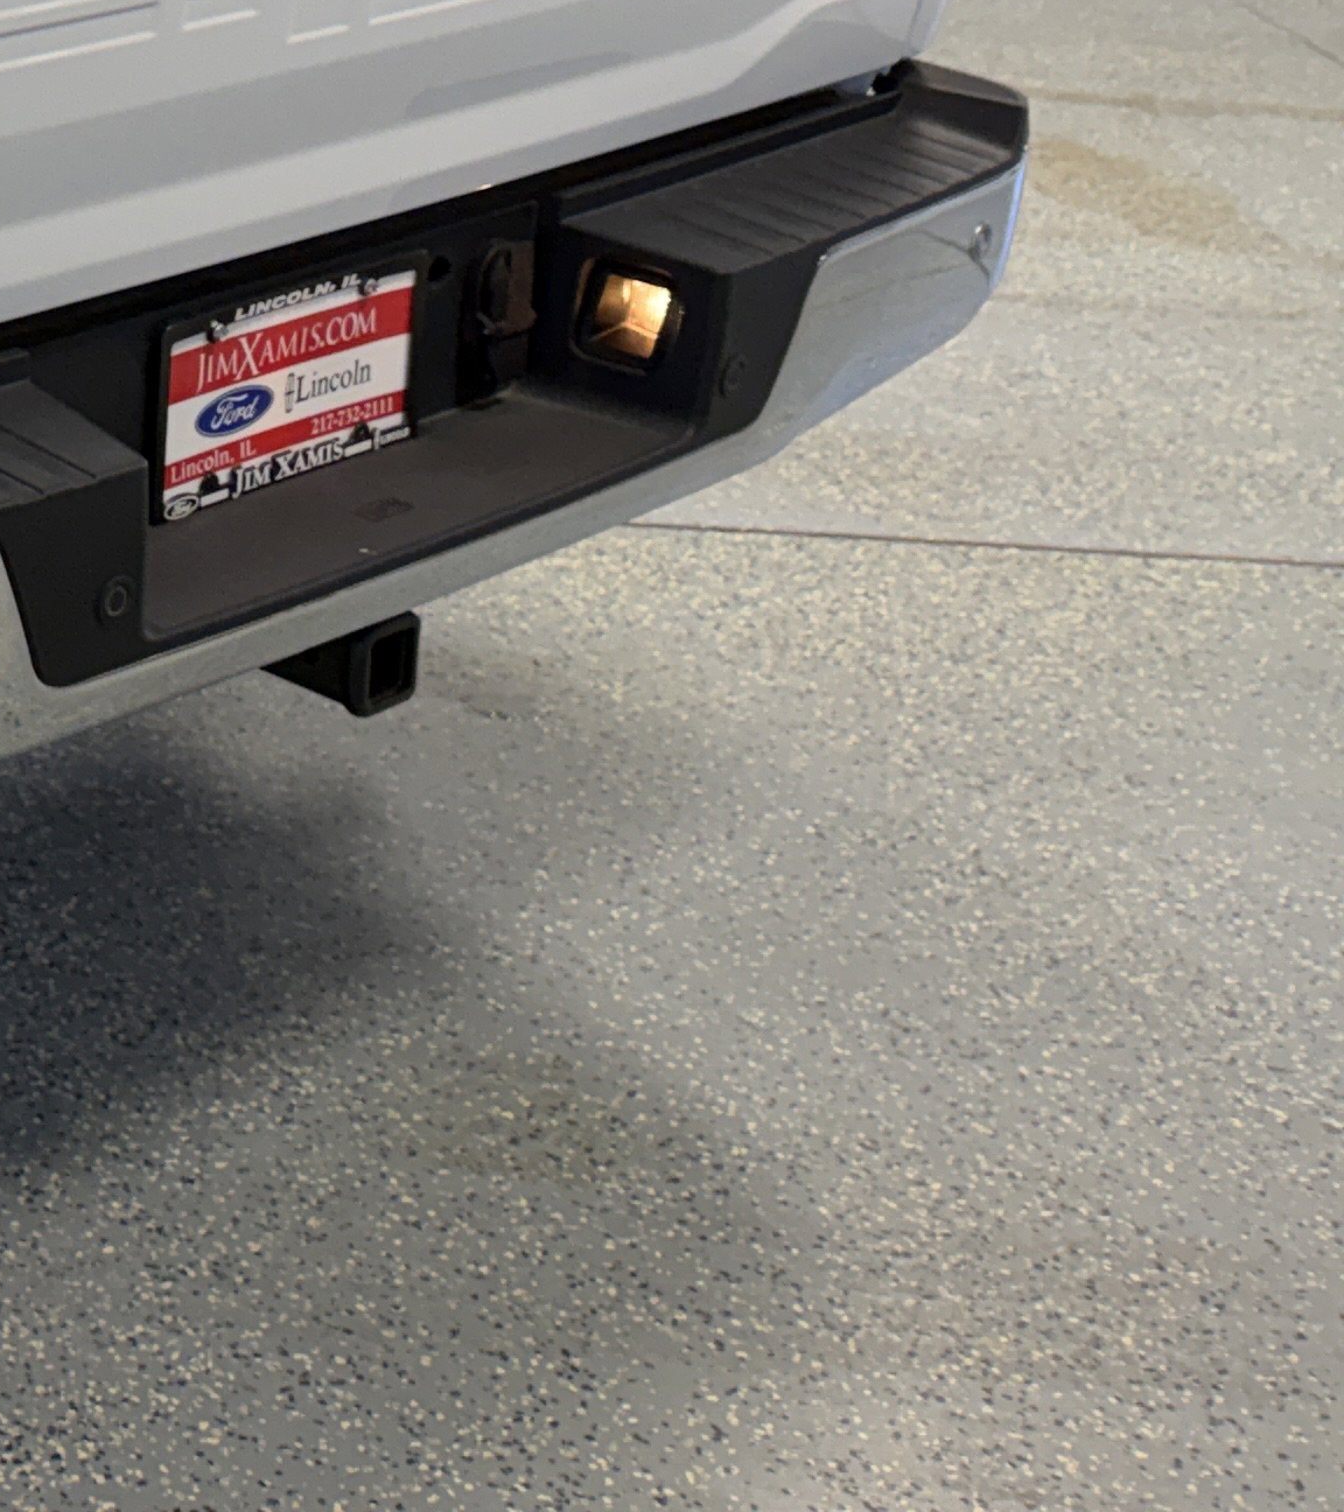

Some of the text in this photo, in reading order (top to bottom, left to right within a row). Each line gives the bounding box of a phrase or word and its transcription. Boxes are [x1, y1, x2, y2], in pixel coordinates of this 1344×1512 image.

[197, 306, 377, 392] JIMXAMIS.COM
[295, 359, 371, 404] Lincoln
[210, 393, 257, 430] Ford
[231, 441, 344, 499] JIM XAMIS
[239, 441, 257, 459] IL
